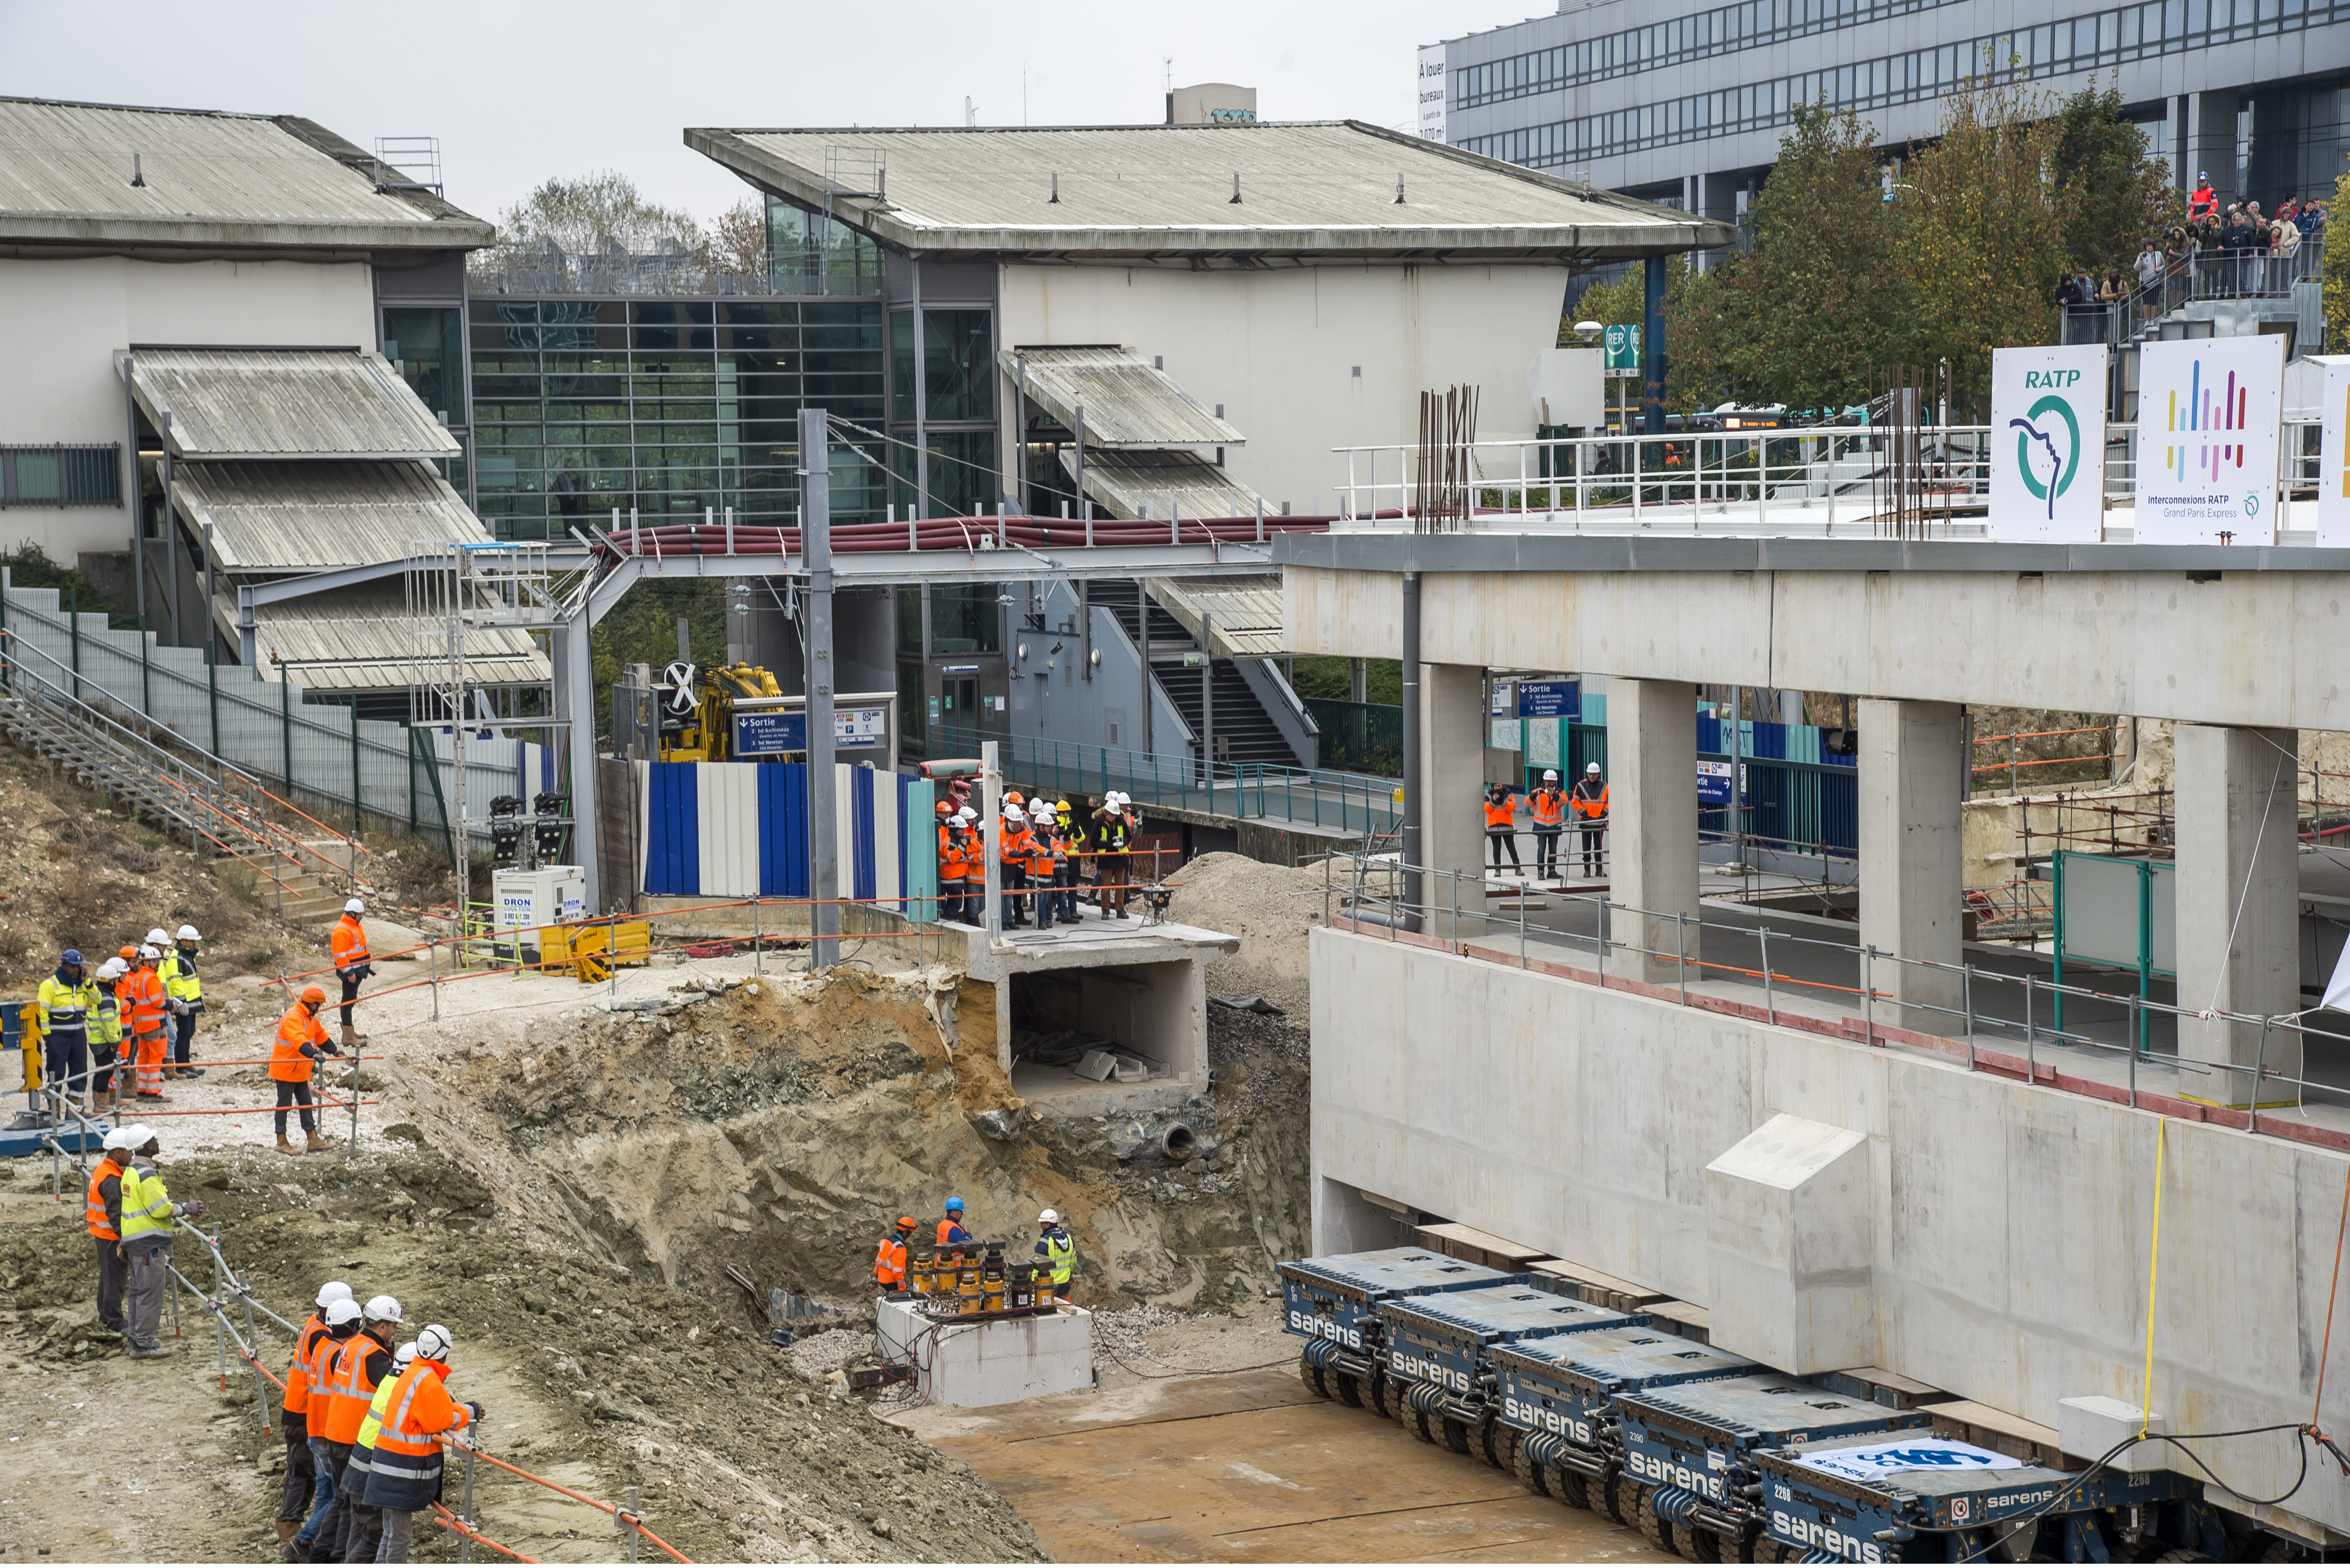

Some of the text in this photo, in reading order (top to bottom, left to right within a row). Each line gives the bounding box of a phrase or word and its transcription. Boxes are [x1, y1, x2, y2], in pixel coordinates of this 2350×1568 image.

[1419, 60, 1444, 79] À louer
[1420, 89, 1443, 104] bureaux
[1426, 110, 1436, 122] partir
[1436, 109, 1441, 117] de
[1608, 332, 1624, 345] RER
[2025, 370, 2081, 389] RATP
[2148, 495, 2229, 504] Interconnexions RATP
[2164, 508, 2237, 519] Grand Paris Express
[1529, 685, 1550, 693] Sortie
[750, 717, 775, 727] Sortie
[563, 899, 579, 907] DRON
[1290, 1310, 1361, 1349] sarens
[1392, 1351, 1469, 1392] sarens
[1505, 1397, 1590, 1443] sarens
[1629, 1431, 1643, 1444] 2390
[1630, 1451, 1725, 1500] sarens
[2128, 1472, 2150, 1487] 2268
[1774, 1484, 1791, 1502] 2268
[1987, 1490, 2053, 1508] sarens
[1773, 1510, 1881, 1564] sarens
